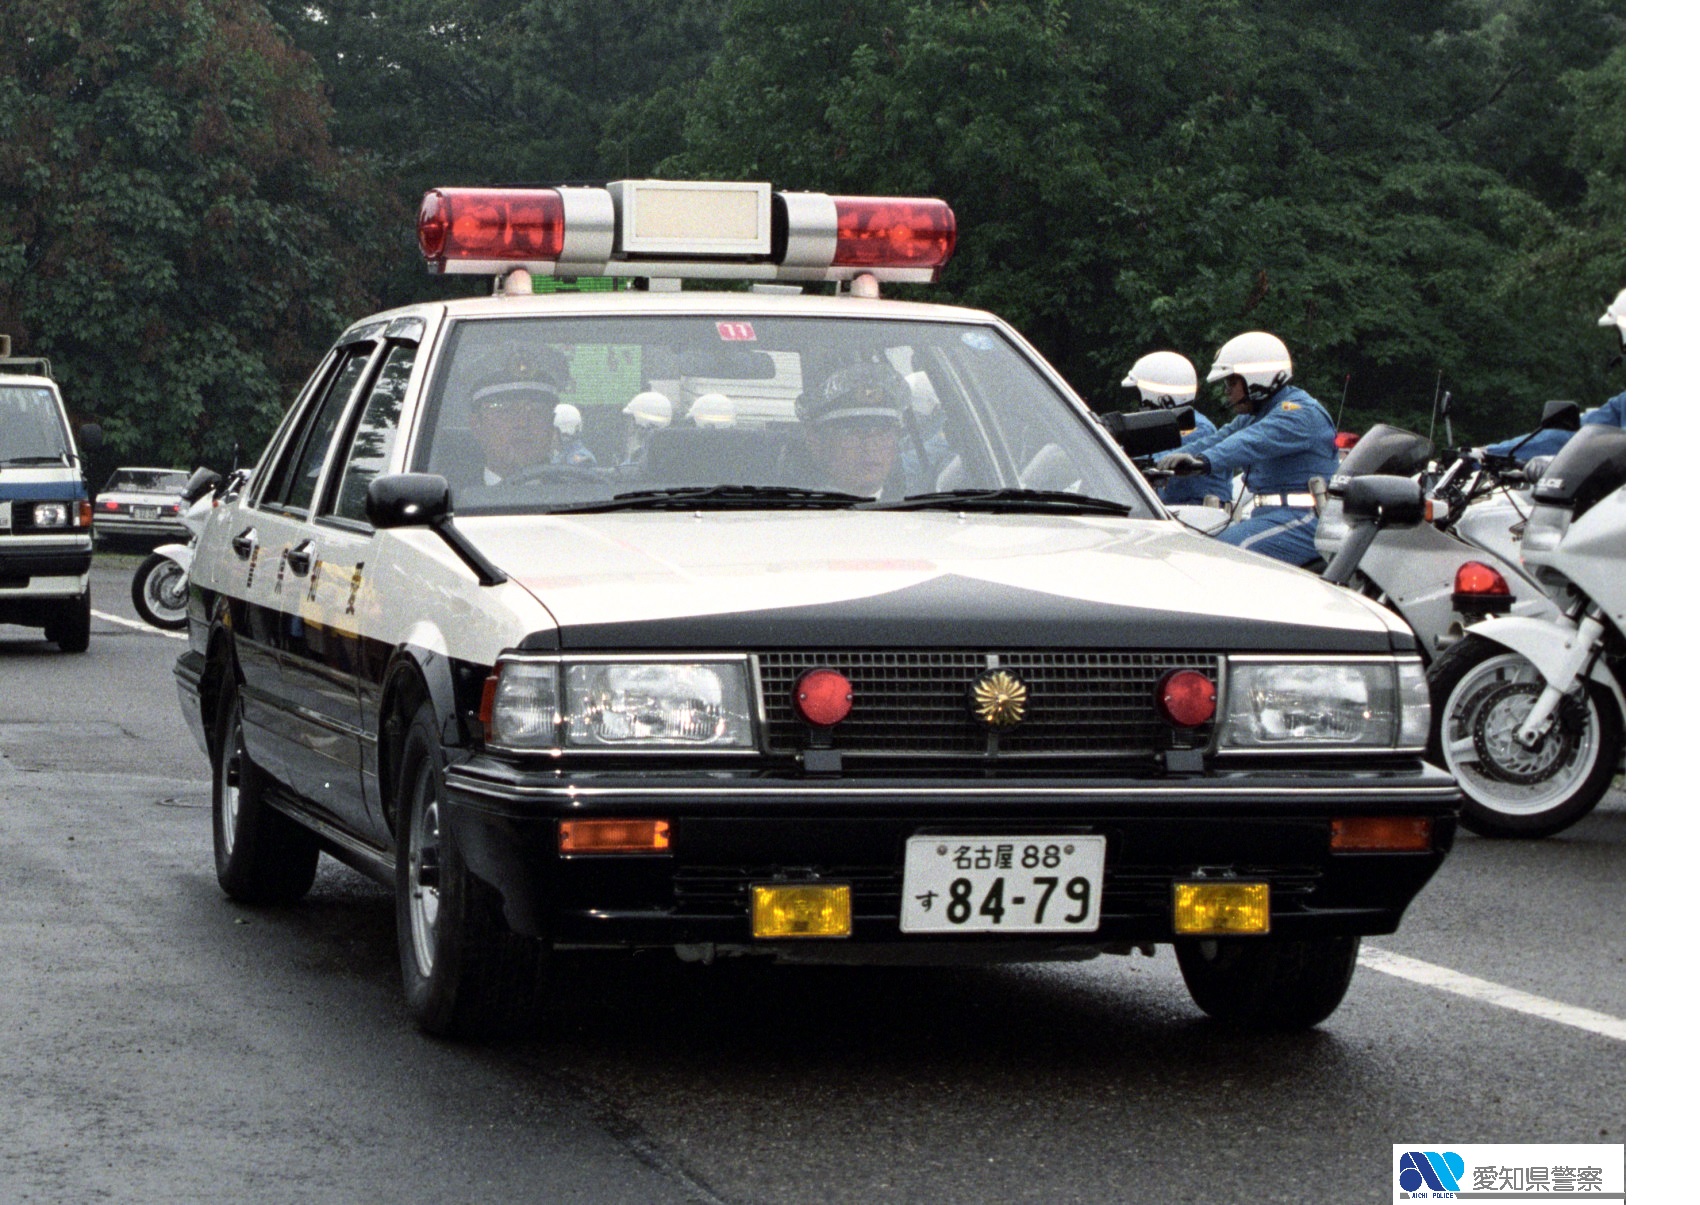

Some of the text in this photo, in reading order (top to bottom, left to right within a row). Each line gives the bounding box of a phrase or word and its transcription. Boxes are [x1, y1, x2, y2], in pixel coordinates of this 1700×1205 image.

[953, 844, 1061, 870] 名古屋 88
[915, 876, 1091, 925] す 84-79
